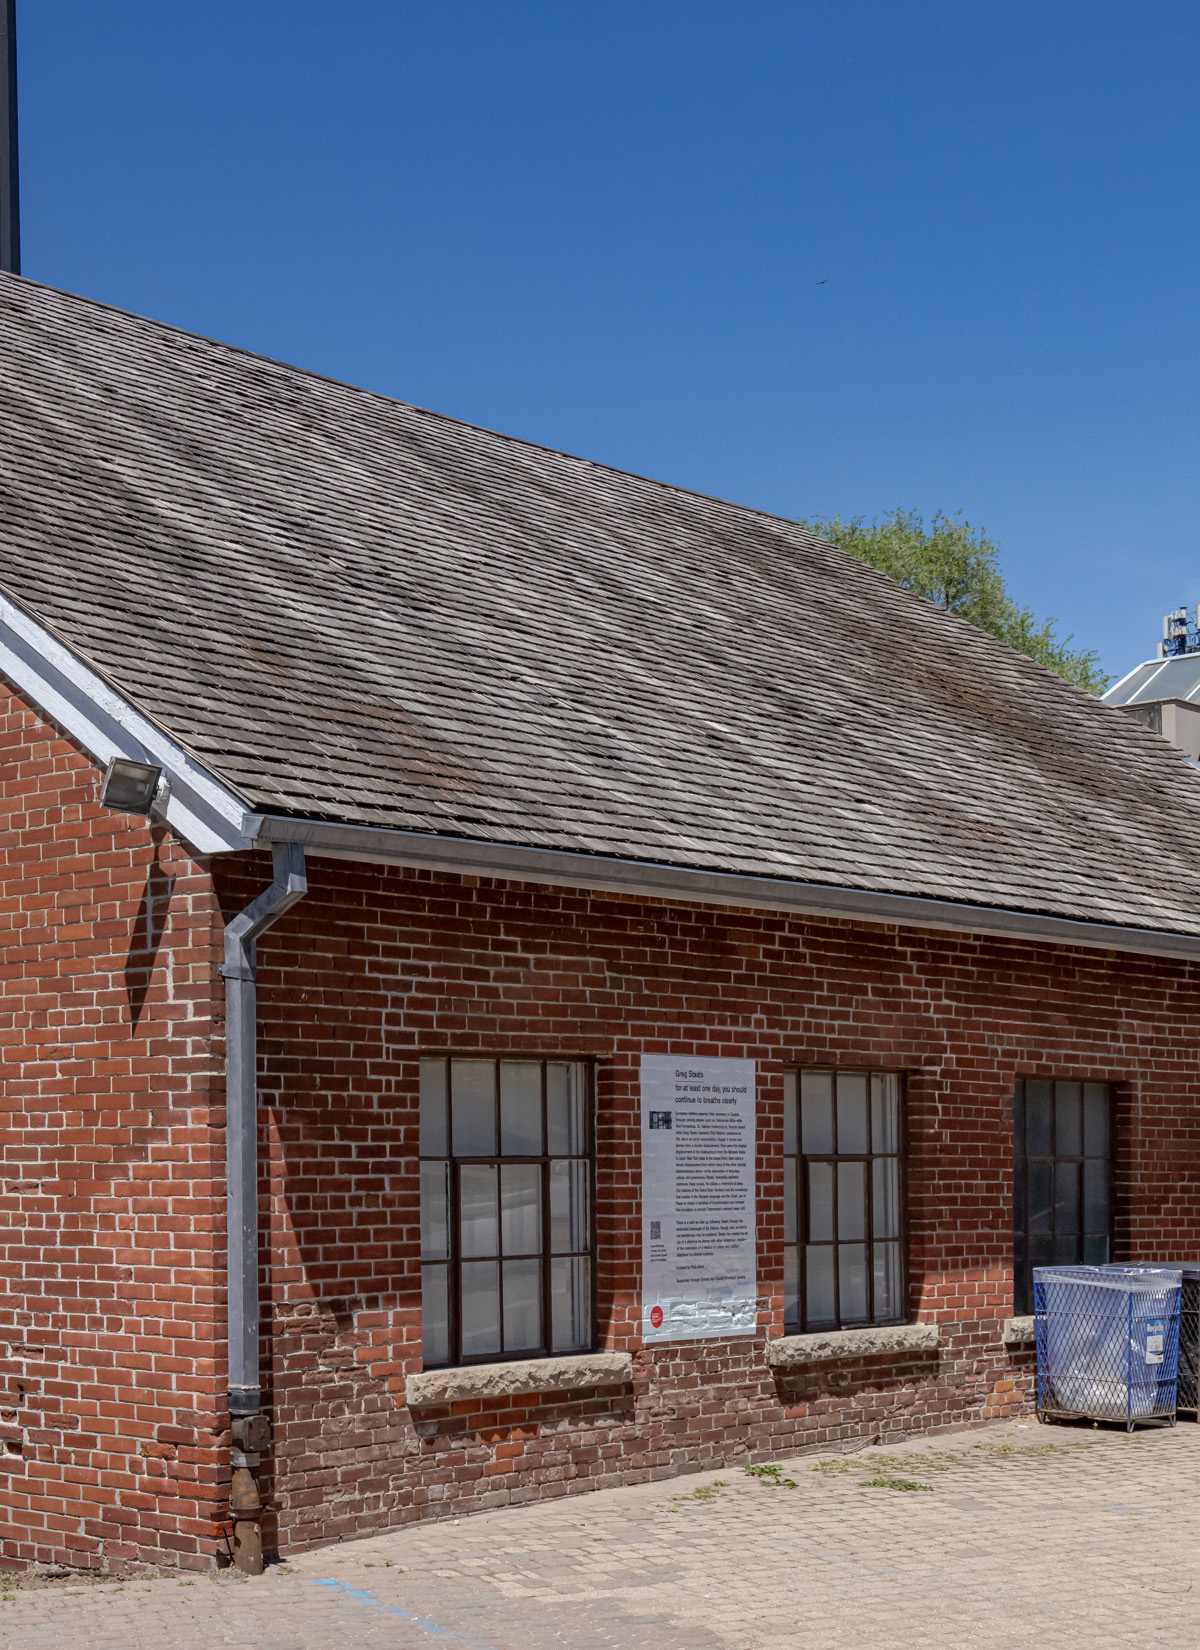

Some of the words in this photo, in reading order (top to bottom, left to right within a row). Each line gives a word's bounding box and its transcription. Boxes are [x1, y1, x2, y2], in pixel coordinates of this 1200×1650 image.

[675, 1069, 688, 1079] Greg
[688, 1070, 704, 1079] Staats
[689, 1084, 701, 1092] least
[711, 1085, 721, 1093] day,
[722, 1086, 731, 1094] you
[731, 1086, 747, 1094] should
[703, 1096, 721, 1104] breathe
[721, 1097, 737, 1106] clearly
[1147, 1322, 1164, 1334] Recycle
